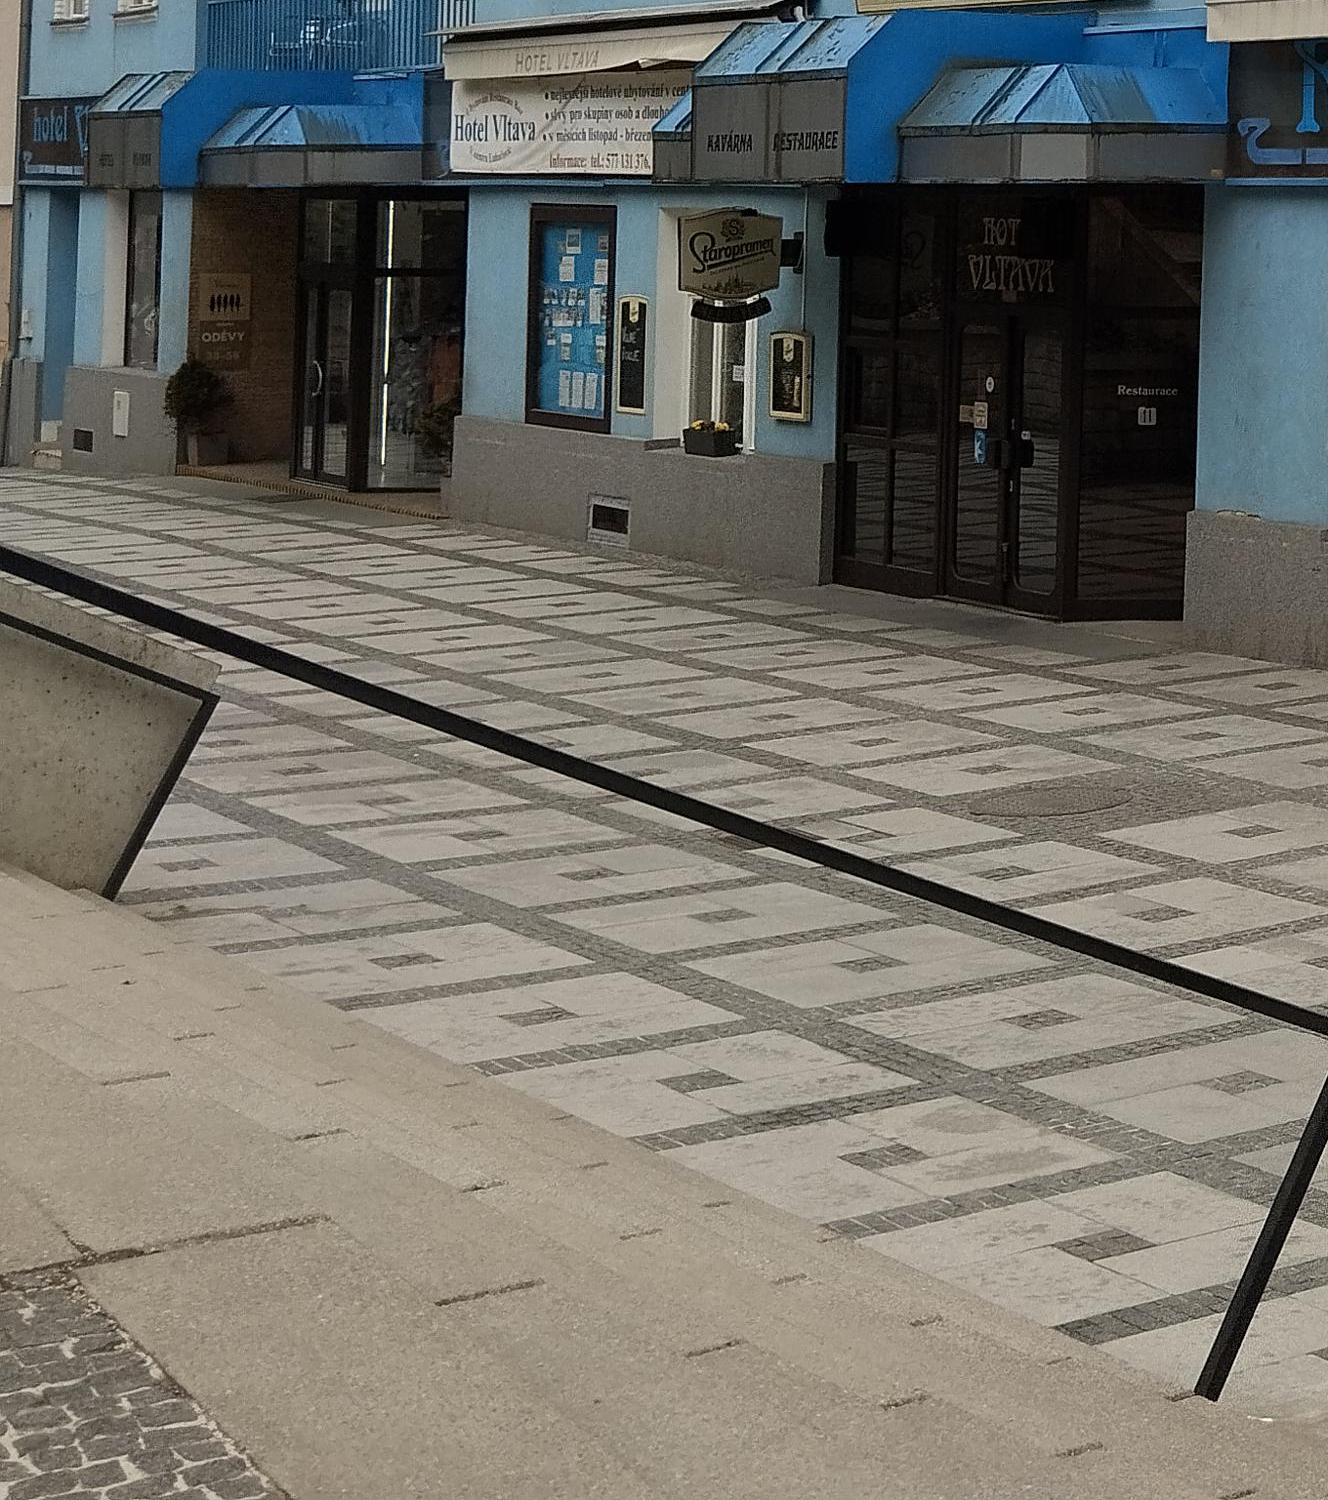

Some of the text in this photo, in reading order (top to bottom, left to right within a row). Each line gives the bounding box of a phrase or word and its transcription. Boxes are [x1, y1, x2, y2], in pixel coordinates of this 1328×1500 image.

[514, 49, 599, 73] HOTEL VLTAVA
[615, 105, 634, 119] osob
[33, 105, 68, 142] hotel
[454, 114, 536, 142] Hotel Vltava
[588, 127, 618, 145] listopad
[706, 129, 839, 154] KAVÁRNA RESTAURACE
[606, 153, 619, 169] 577
[620, 153, 634, 169] 131
[688, 232, 777, 274] Staropramen
[201, 329, 246, 343] ODĚVY
[1117, 384, 1179, 396] Restaurace
